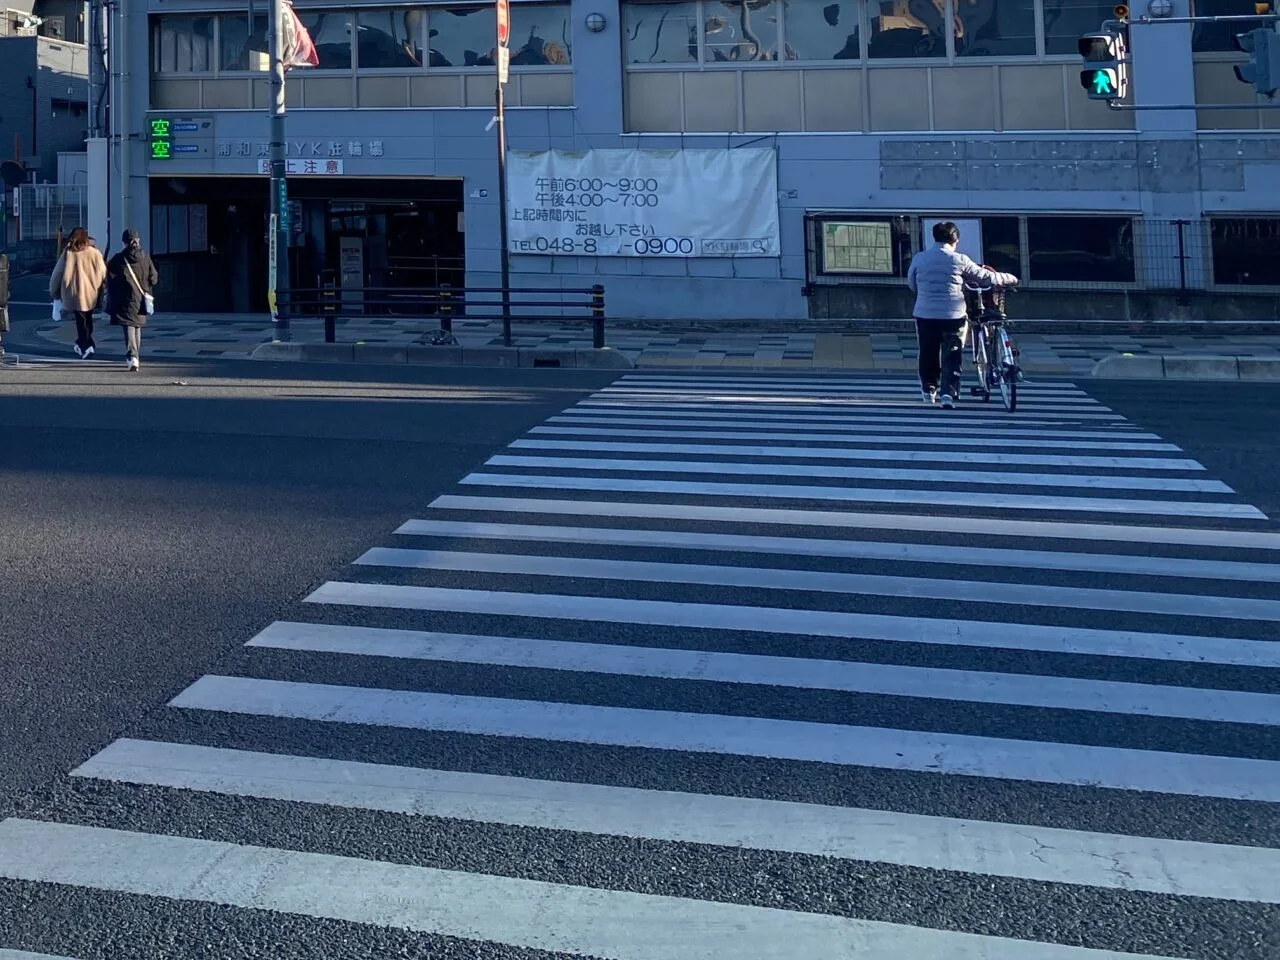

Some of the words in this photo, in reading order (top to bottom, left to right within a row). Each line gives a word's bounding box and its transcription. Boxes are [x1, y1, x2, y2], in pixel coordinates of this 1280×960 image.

[151, 119, 170, 136] 空
[151, 141, 170, 157] 空
[511, 208, 587, 222] 上記時間内に
[575, 223, 655, 237] お越し下さい
